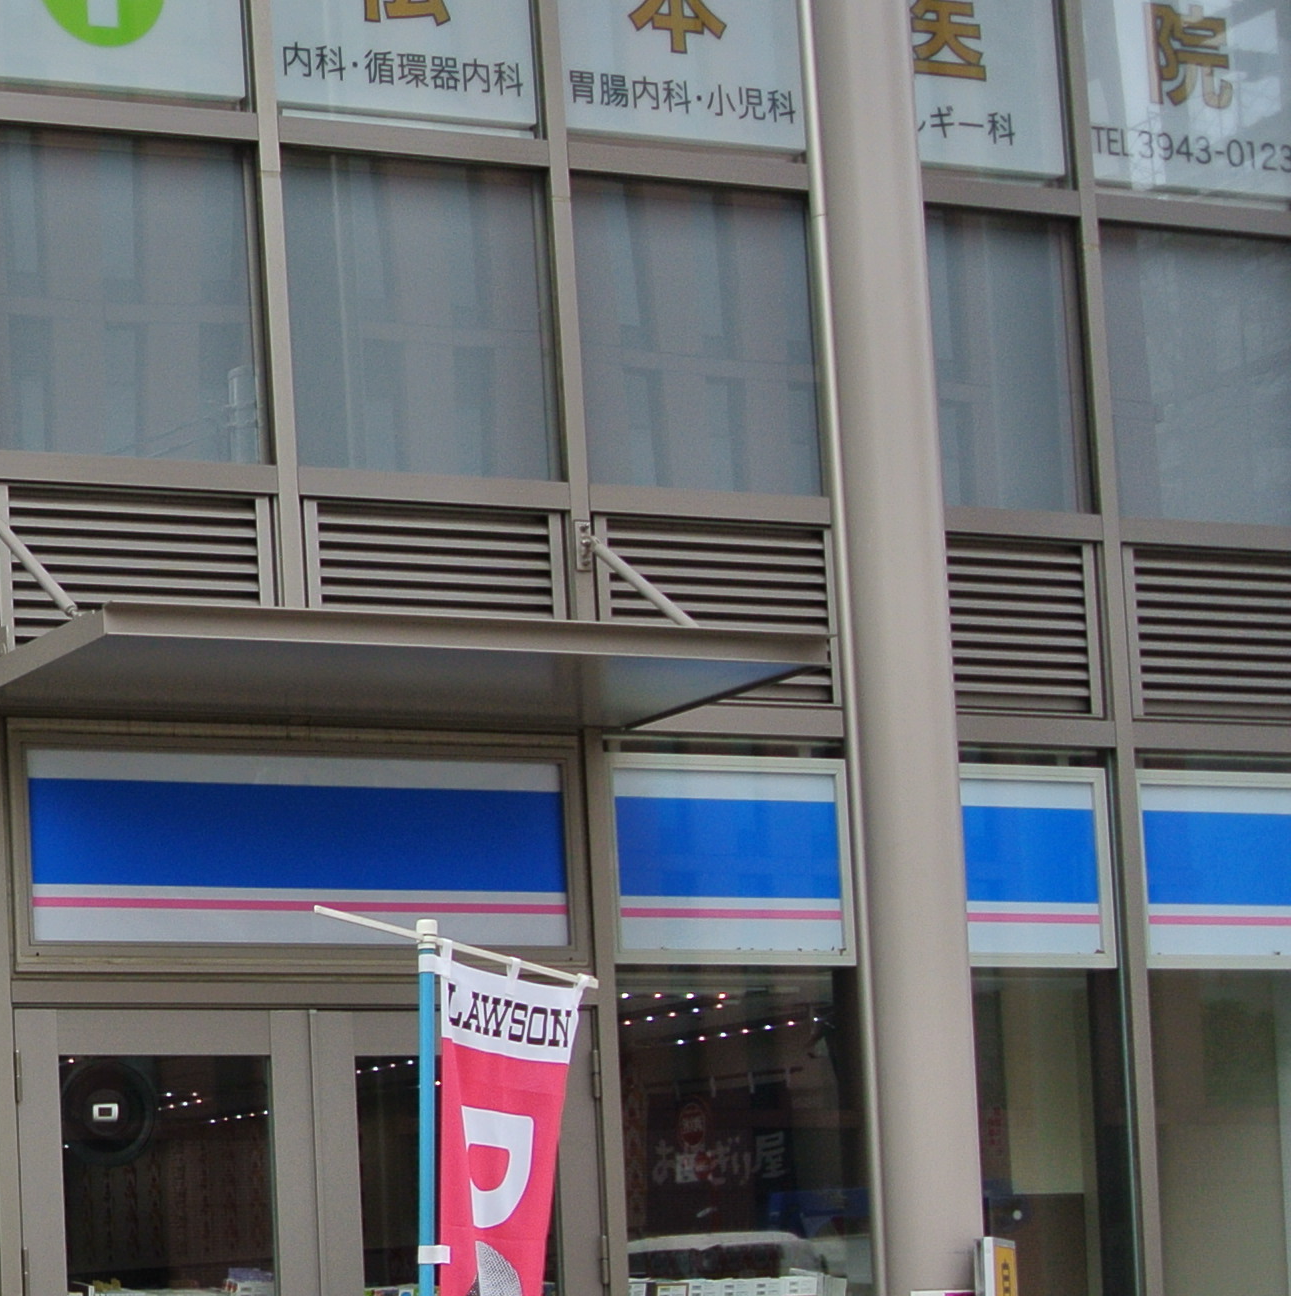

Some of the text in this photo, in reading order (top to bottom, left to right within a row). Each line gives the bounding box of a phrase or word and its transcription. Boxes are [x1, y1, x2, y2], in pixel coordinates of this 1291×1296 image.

[282, 41, 524, 97] 内科・循環器内科
[568, 69, 797, 125] 胃腸内科・小児科
[918, 106, 1016, 146] ギー科
[1091, 125, 1291, 172] TEL 3943-0123
[447, 983, 573, 1047] LAWSON
